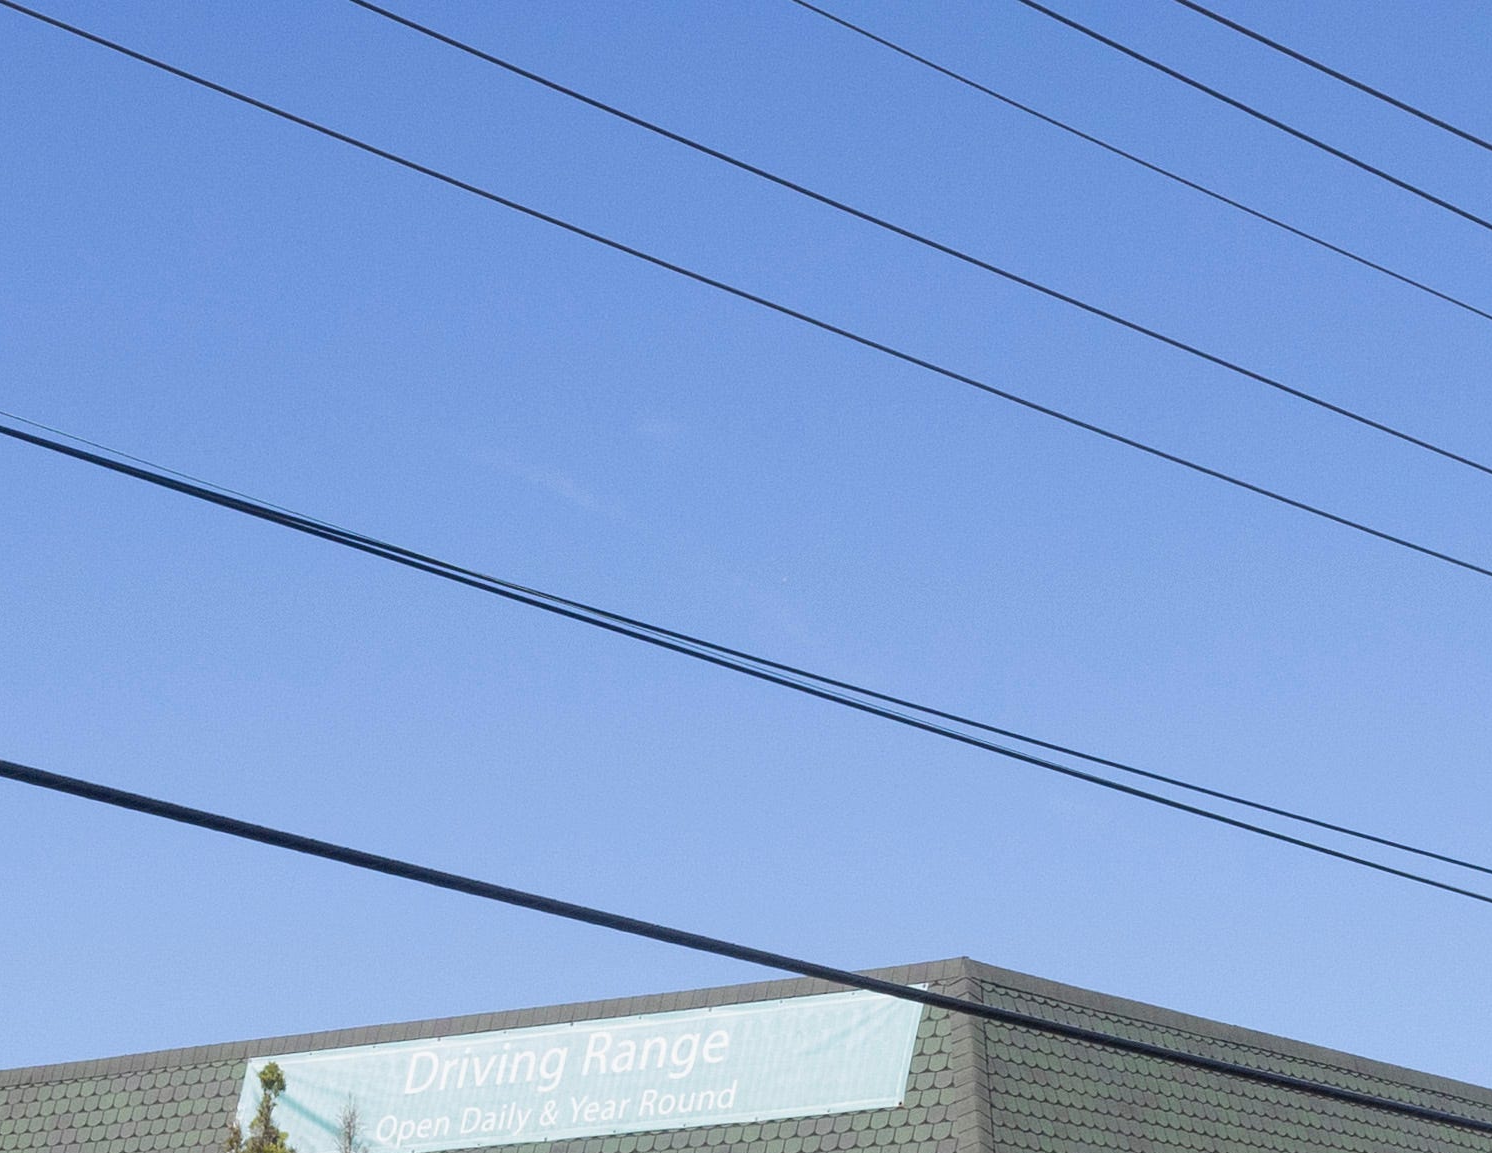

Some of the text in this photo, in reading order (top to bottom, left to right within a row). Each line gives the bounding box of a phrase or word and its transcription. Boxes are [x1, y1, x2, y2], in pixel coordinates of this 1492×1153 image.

[404, 1029, 731, 1095] Driving Range
[375, 1079, 739, 1148] Open Daily & Year Round
